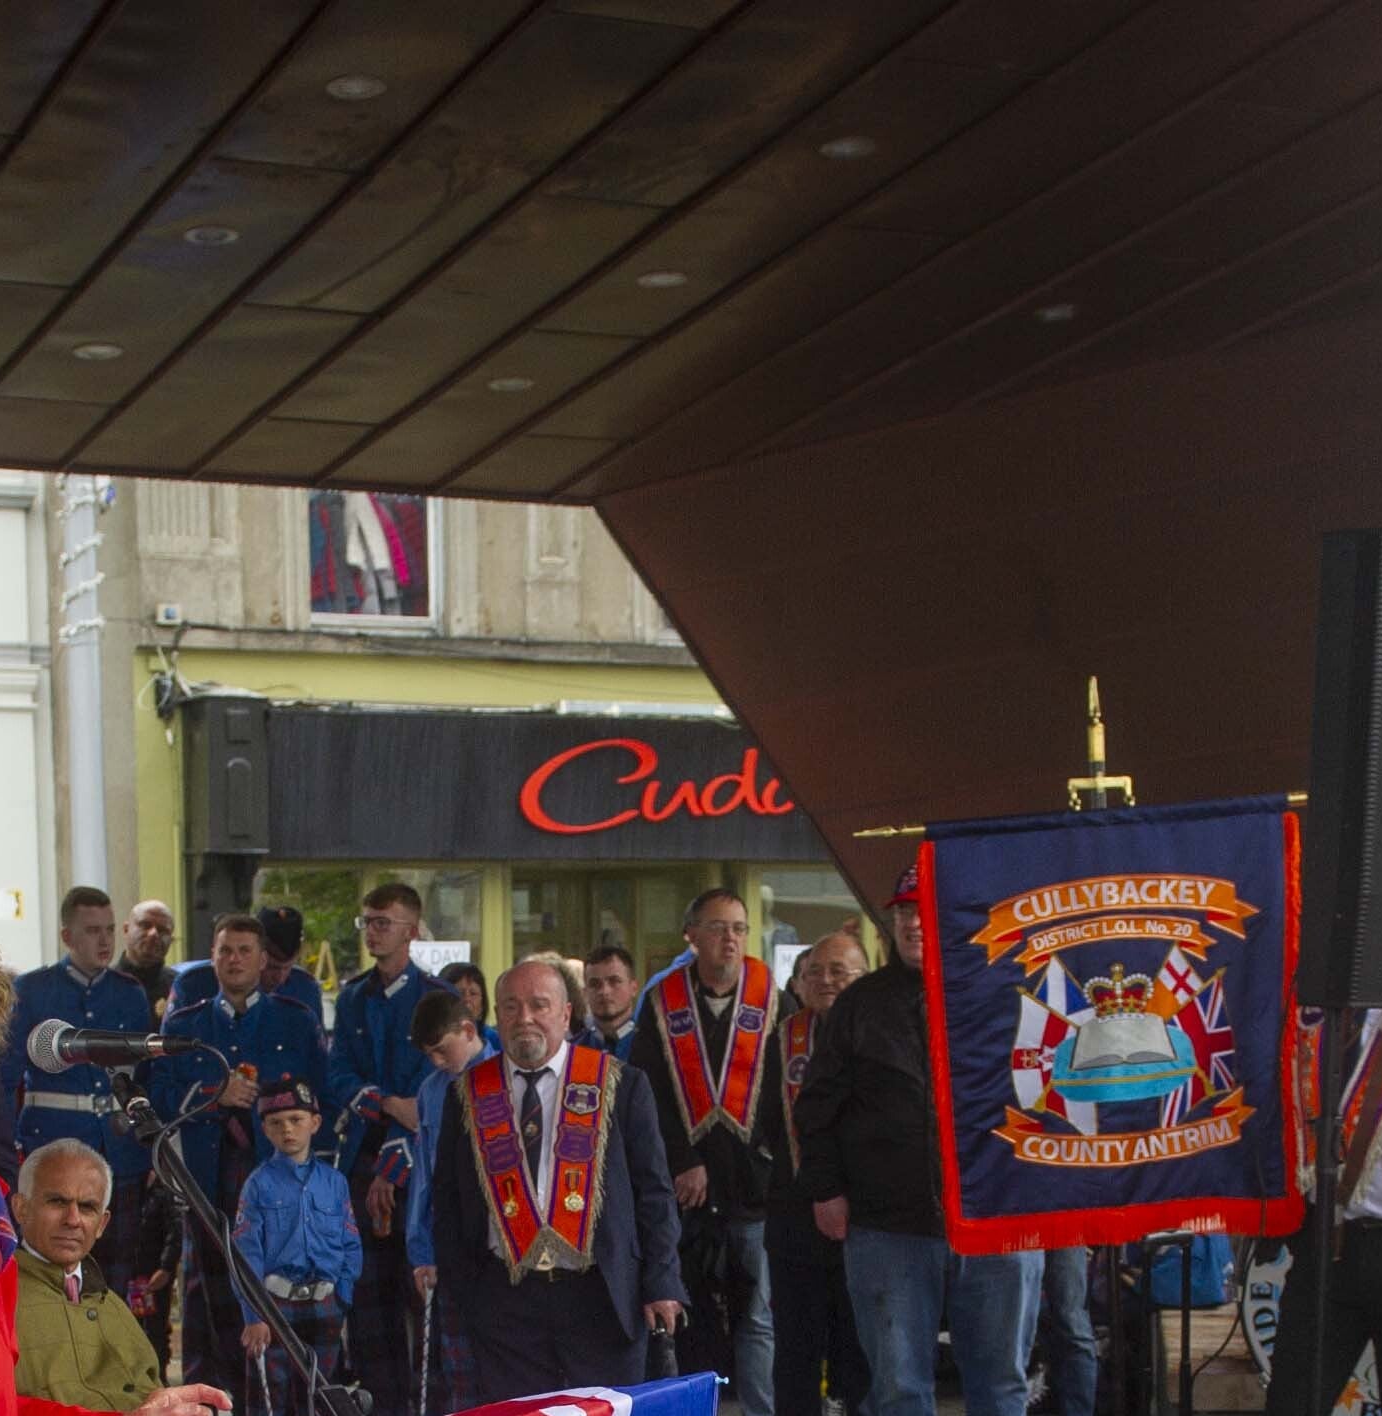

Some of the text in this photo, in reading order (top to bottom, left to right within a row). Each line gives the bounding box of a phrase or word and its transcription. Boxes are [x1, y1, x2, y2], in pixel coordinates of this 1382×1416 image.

[1011, 879, 1216, 923] CULLYBACKEY
[1031, 919, 1193, 951] DISTRICT L.O.L. No. 20
[1021, 1118, 1233, 1162] COUNTY ANTRIM
